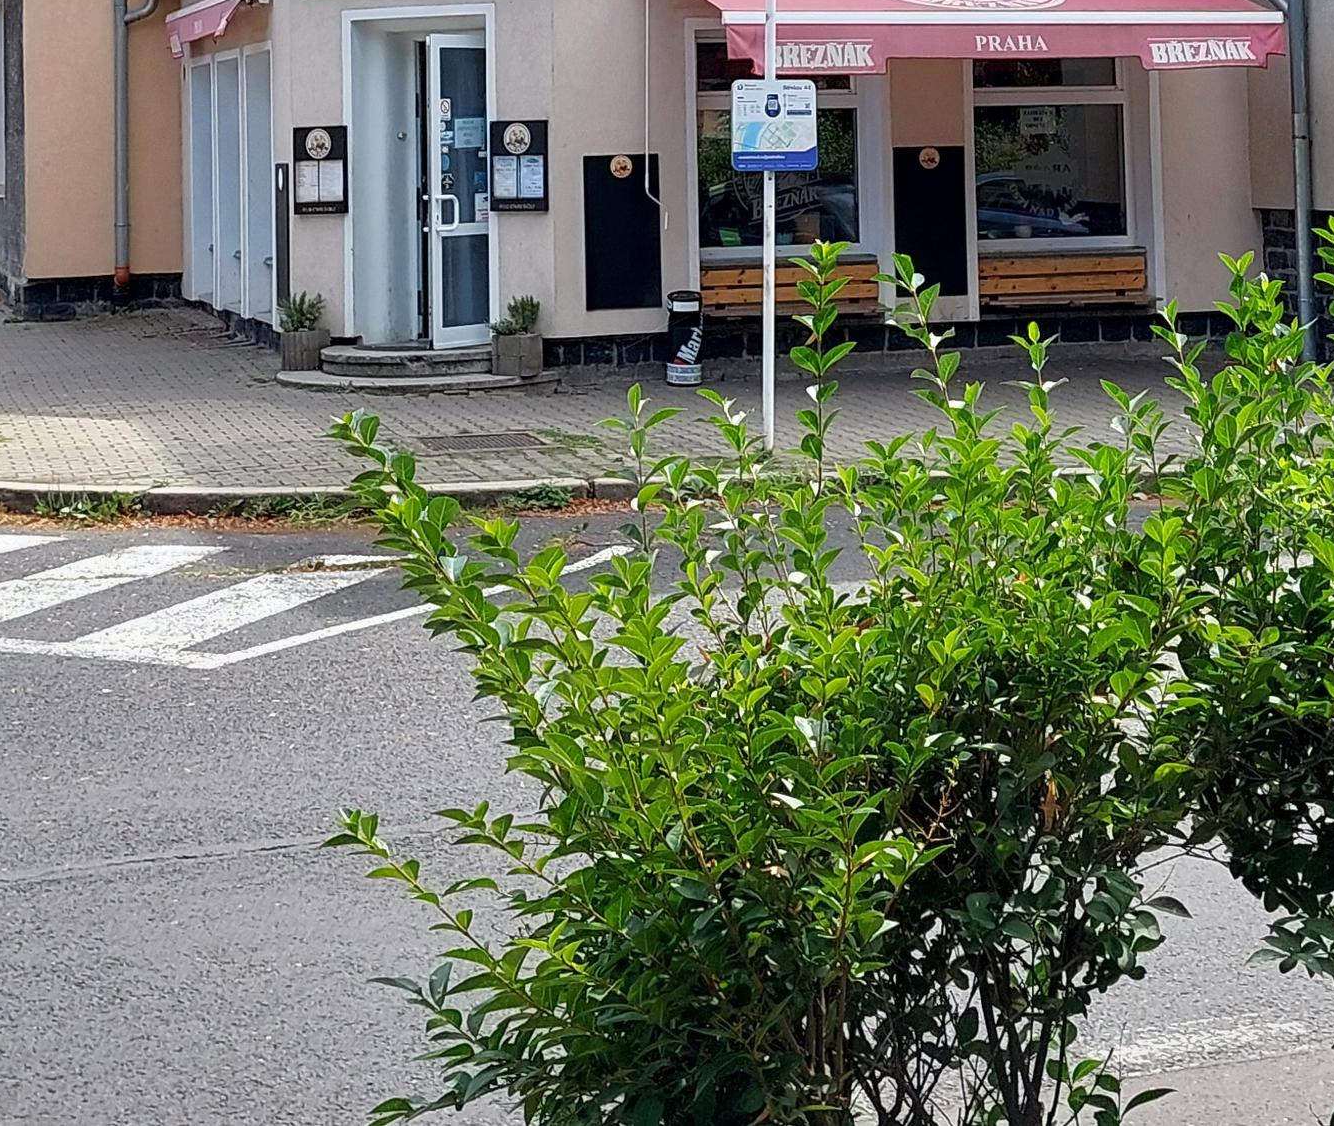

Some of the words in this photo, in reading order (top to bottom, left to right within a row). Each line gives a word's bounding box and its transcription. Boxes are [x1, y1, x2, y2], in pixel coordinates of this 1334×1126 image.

[975, 35, 1049, 52] PRAHA
[1149, 39, 1256, 64] BŘEZŇÁK
[1029, 204, 1055, 218] NAD
